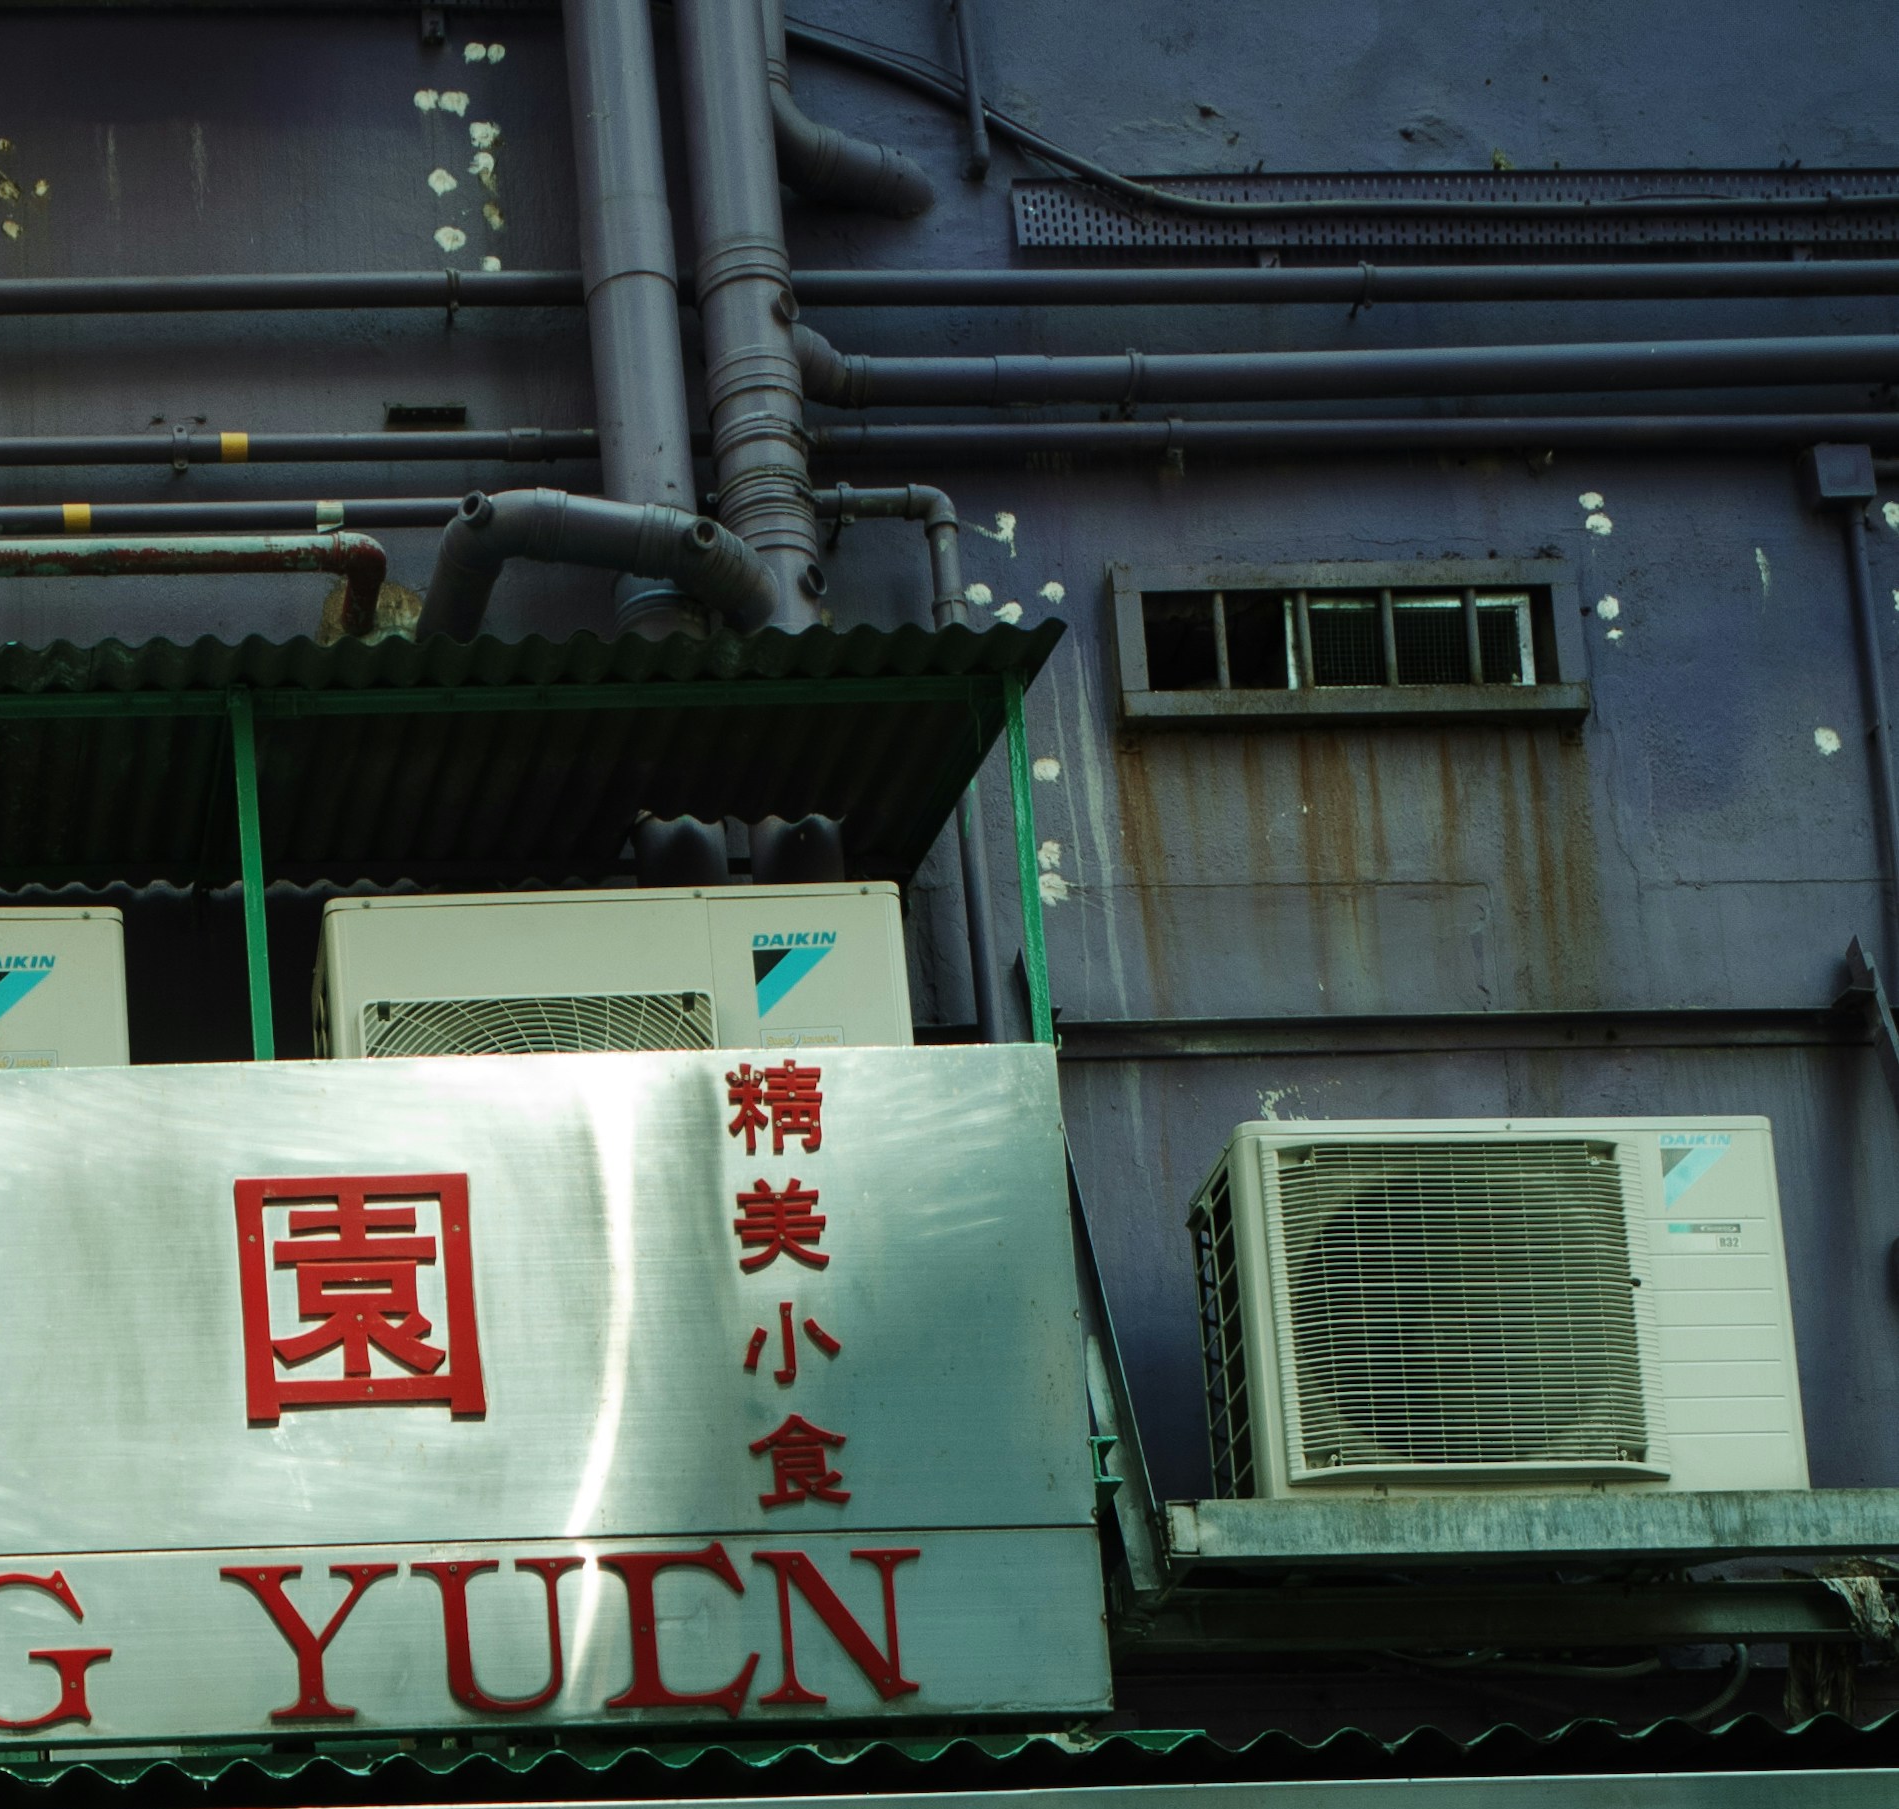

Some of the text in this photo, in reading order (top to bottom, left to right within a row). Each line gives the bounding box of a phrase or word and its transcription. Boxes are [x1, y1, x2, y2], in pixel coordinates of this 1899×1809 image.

[752, 931, 836, 946] DAIKIN
[1660, 1134, 1730, 1145] DAIKIN
[725, 1060, 849, 1506] 精美小食
[221, 1548, 922, 1726] YUEN
